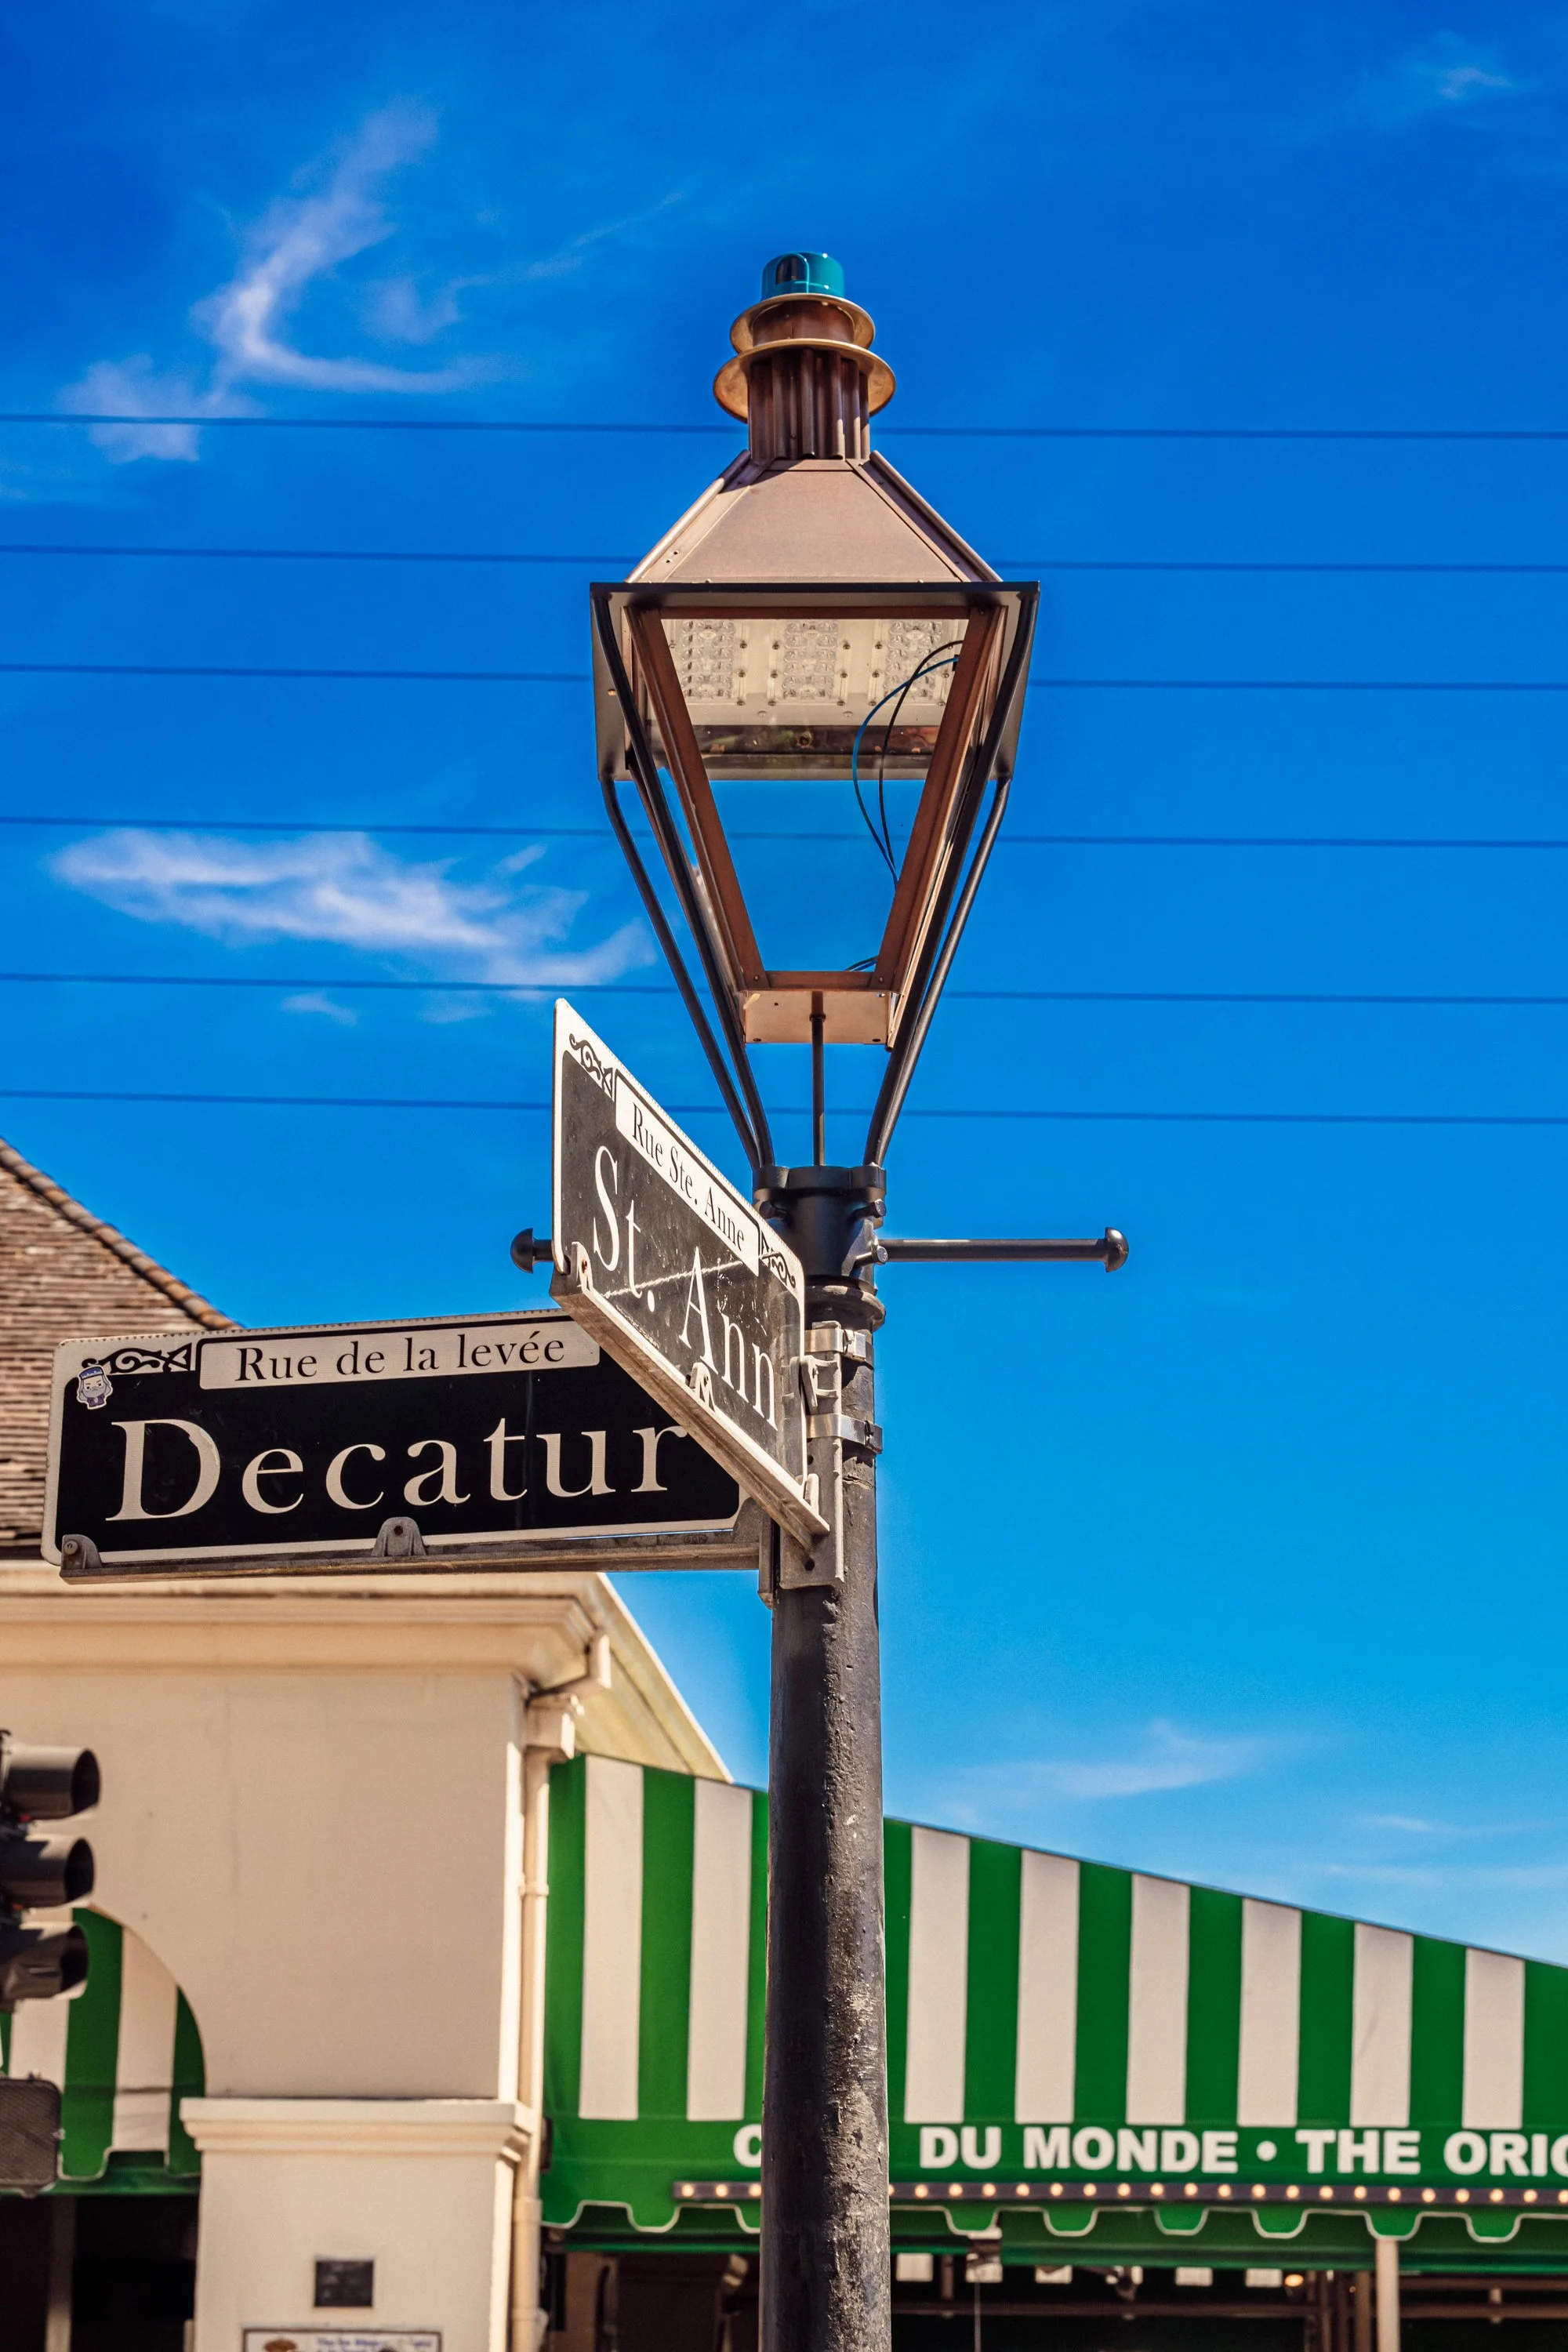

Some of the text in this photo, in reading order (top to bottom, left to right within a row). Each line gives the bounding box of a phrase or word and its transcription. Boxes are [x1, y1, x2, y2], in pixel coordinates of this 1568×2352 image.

[632, 1103, 746, 1252] Rue Ste. Anne
[593, 1145, 656, 1313] St.
[678, 1246, 779, 1431] Ann
[236, 1330, 564, 1382] Rue de la levée
[106, 1417, 688, 1522] Decatur
[920, 2126, 1002, 2169] DU
[1023, 2126, 1239, 2174] MONDE
[1294, 2129, 1421, 2175] THE
